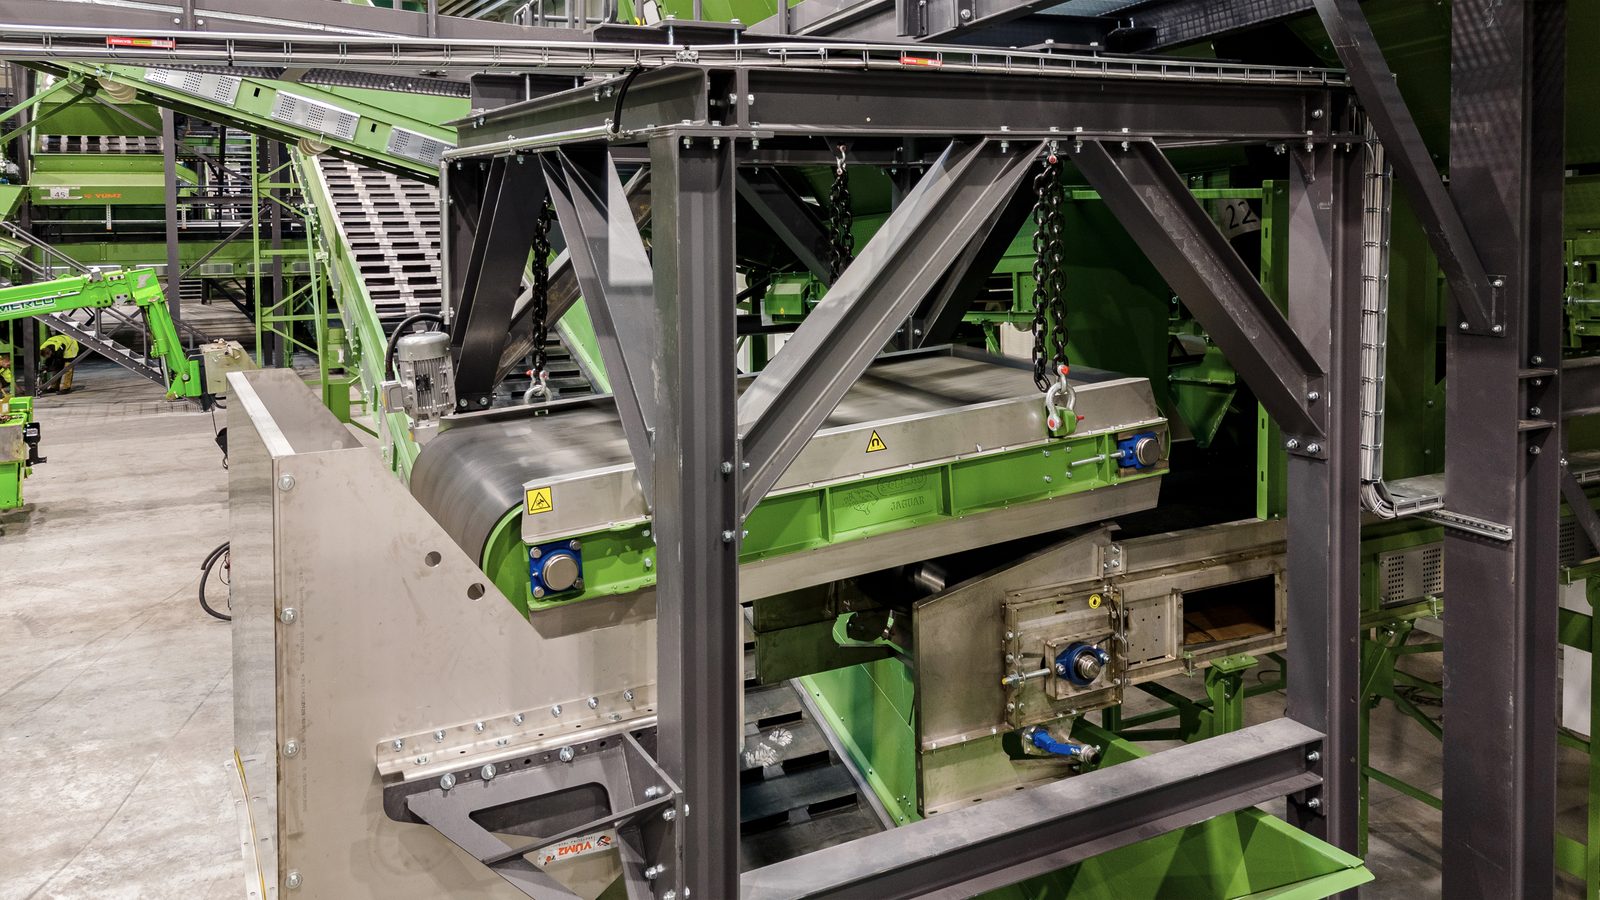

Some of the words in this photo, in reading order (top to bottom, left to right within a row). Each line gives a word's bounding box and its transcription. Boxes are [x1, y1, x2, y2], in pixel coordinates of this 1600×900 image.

[54, 191, 66, 199] 45
[1225, 200, 1257, 230] 22
[890, 495, 925, 512] JAGUAR
